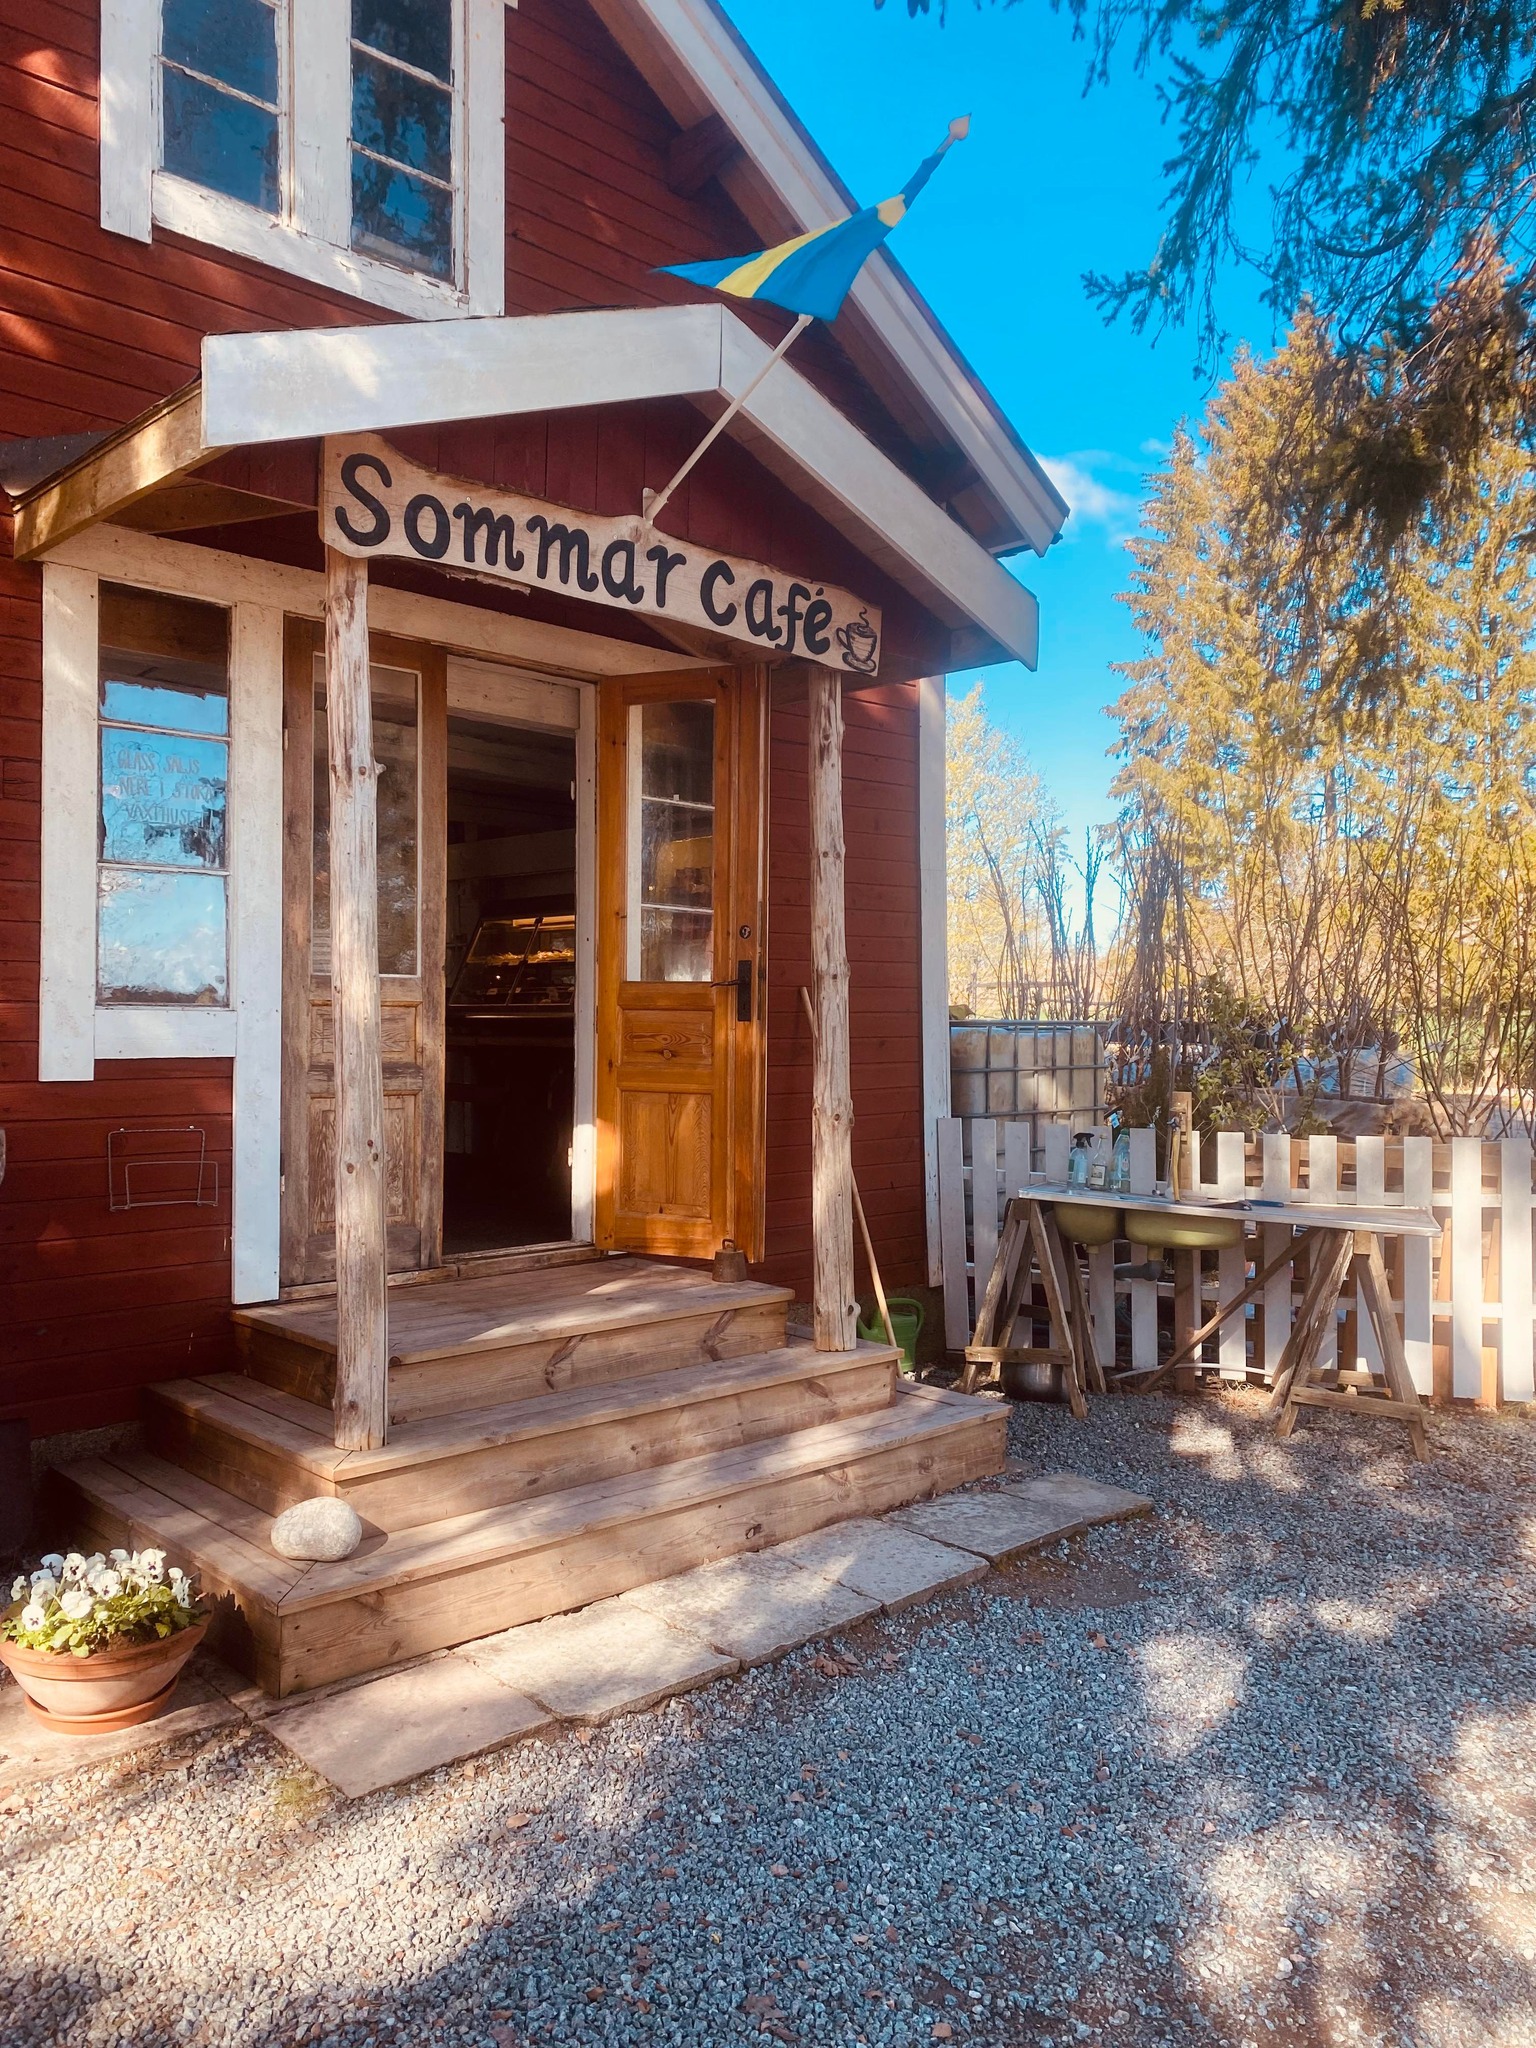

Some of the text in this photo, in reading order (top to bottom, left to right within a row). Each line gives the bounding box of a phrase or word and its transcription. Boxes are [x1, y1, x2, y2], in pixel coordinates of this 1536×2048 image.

[335, 453, 832, 656] Sommar café
[117, 750, 155, 772] GLASS
